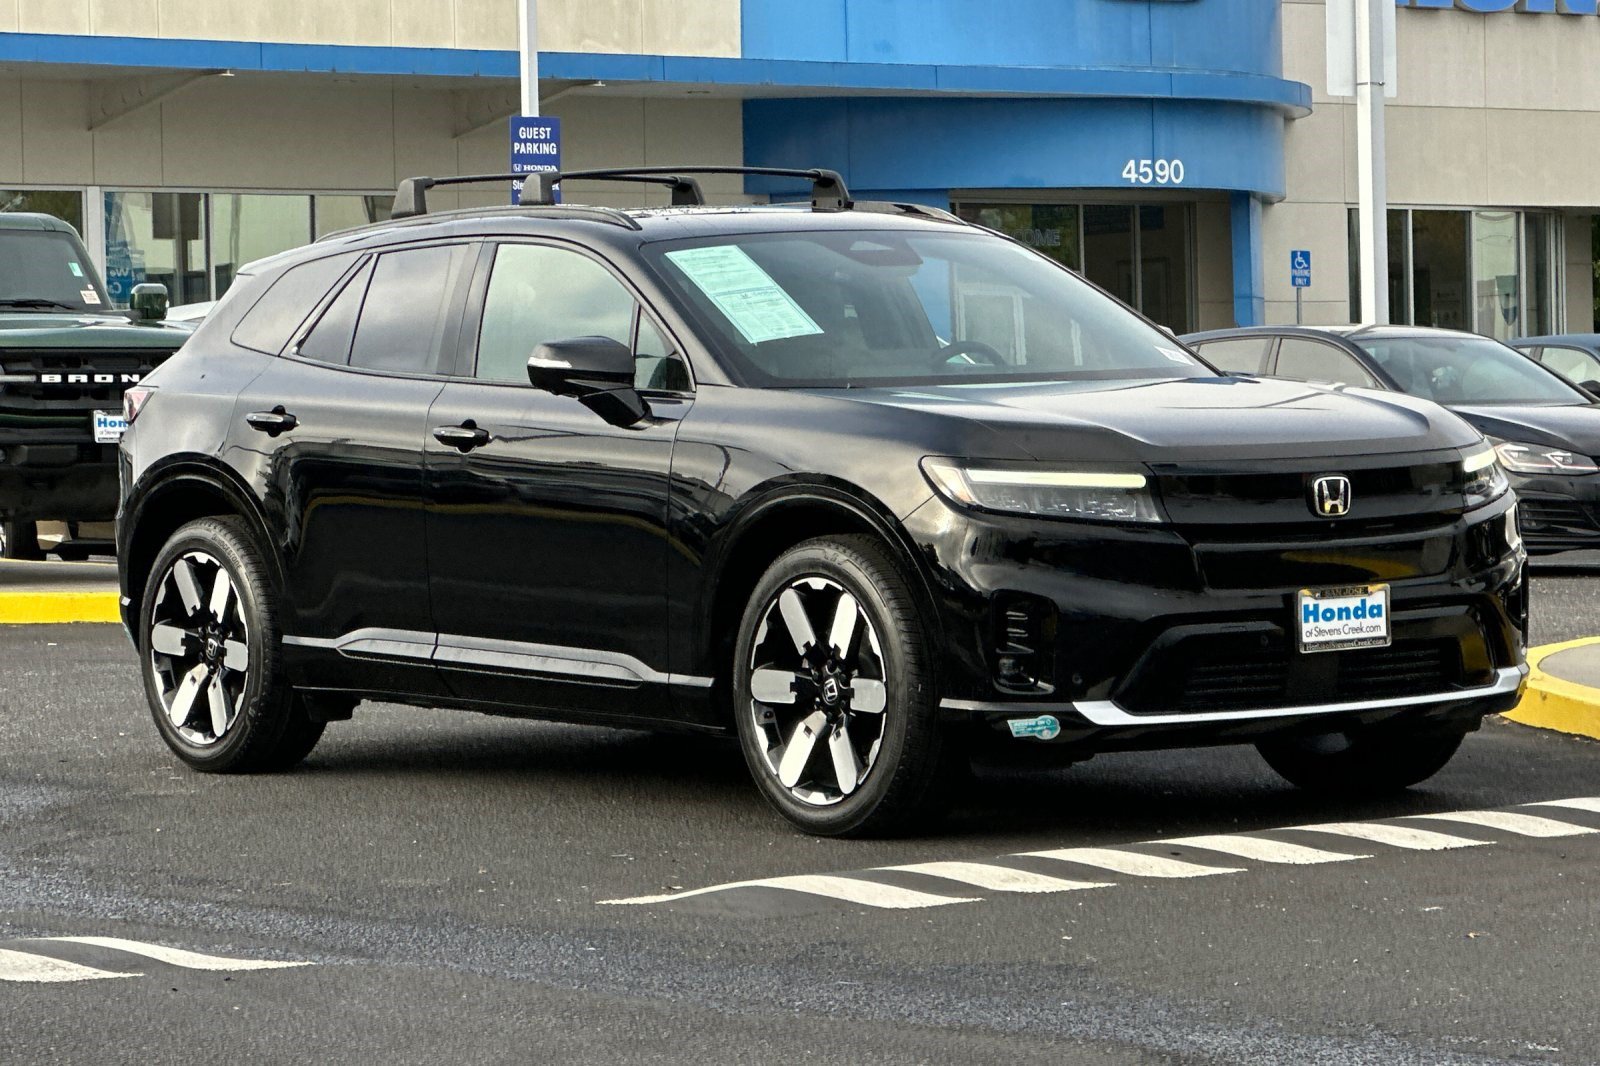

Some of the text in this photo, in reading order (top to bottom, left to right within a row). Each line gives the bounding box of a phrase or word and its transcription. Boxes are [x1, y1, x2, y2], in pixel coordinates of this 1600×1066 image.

[519, 127, 551, 139] GUEST
[513, 142, 557, 155] PARKING
[523, 164, 558, 172] HONDA
[1122, 159, 1184, 184] 4590
[41, 373, 140, 383] BRON
[97, 417, 128, 428] Hon
[1303, 599, 1383, 623] Honda
[1305, 622, 1381, 638] of Stevens Creek.com
